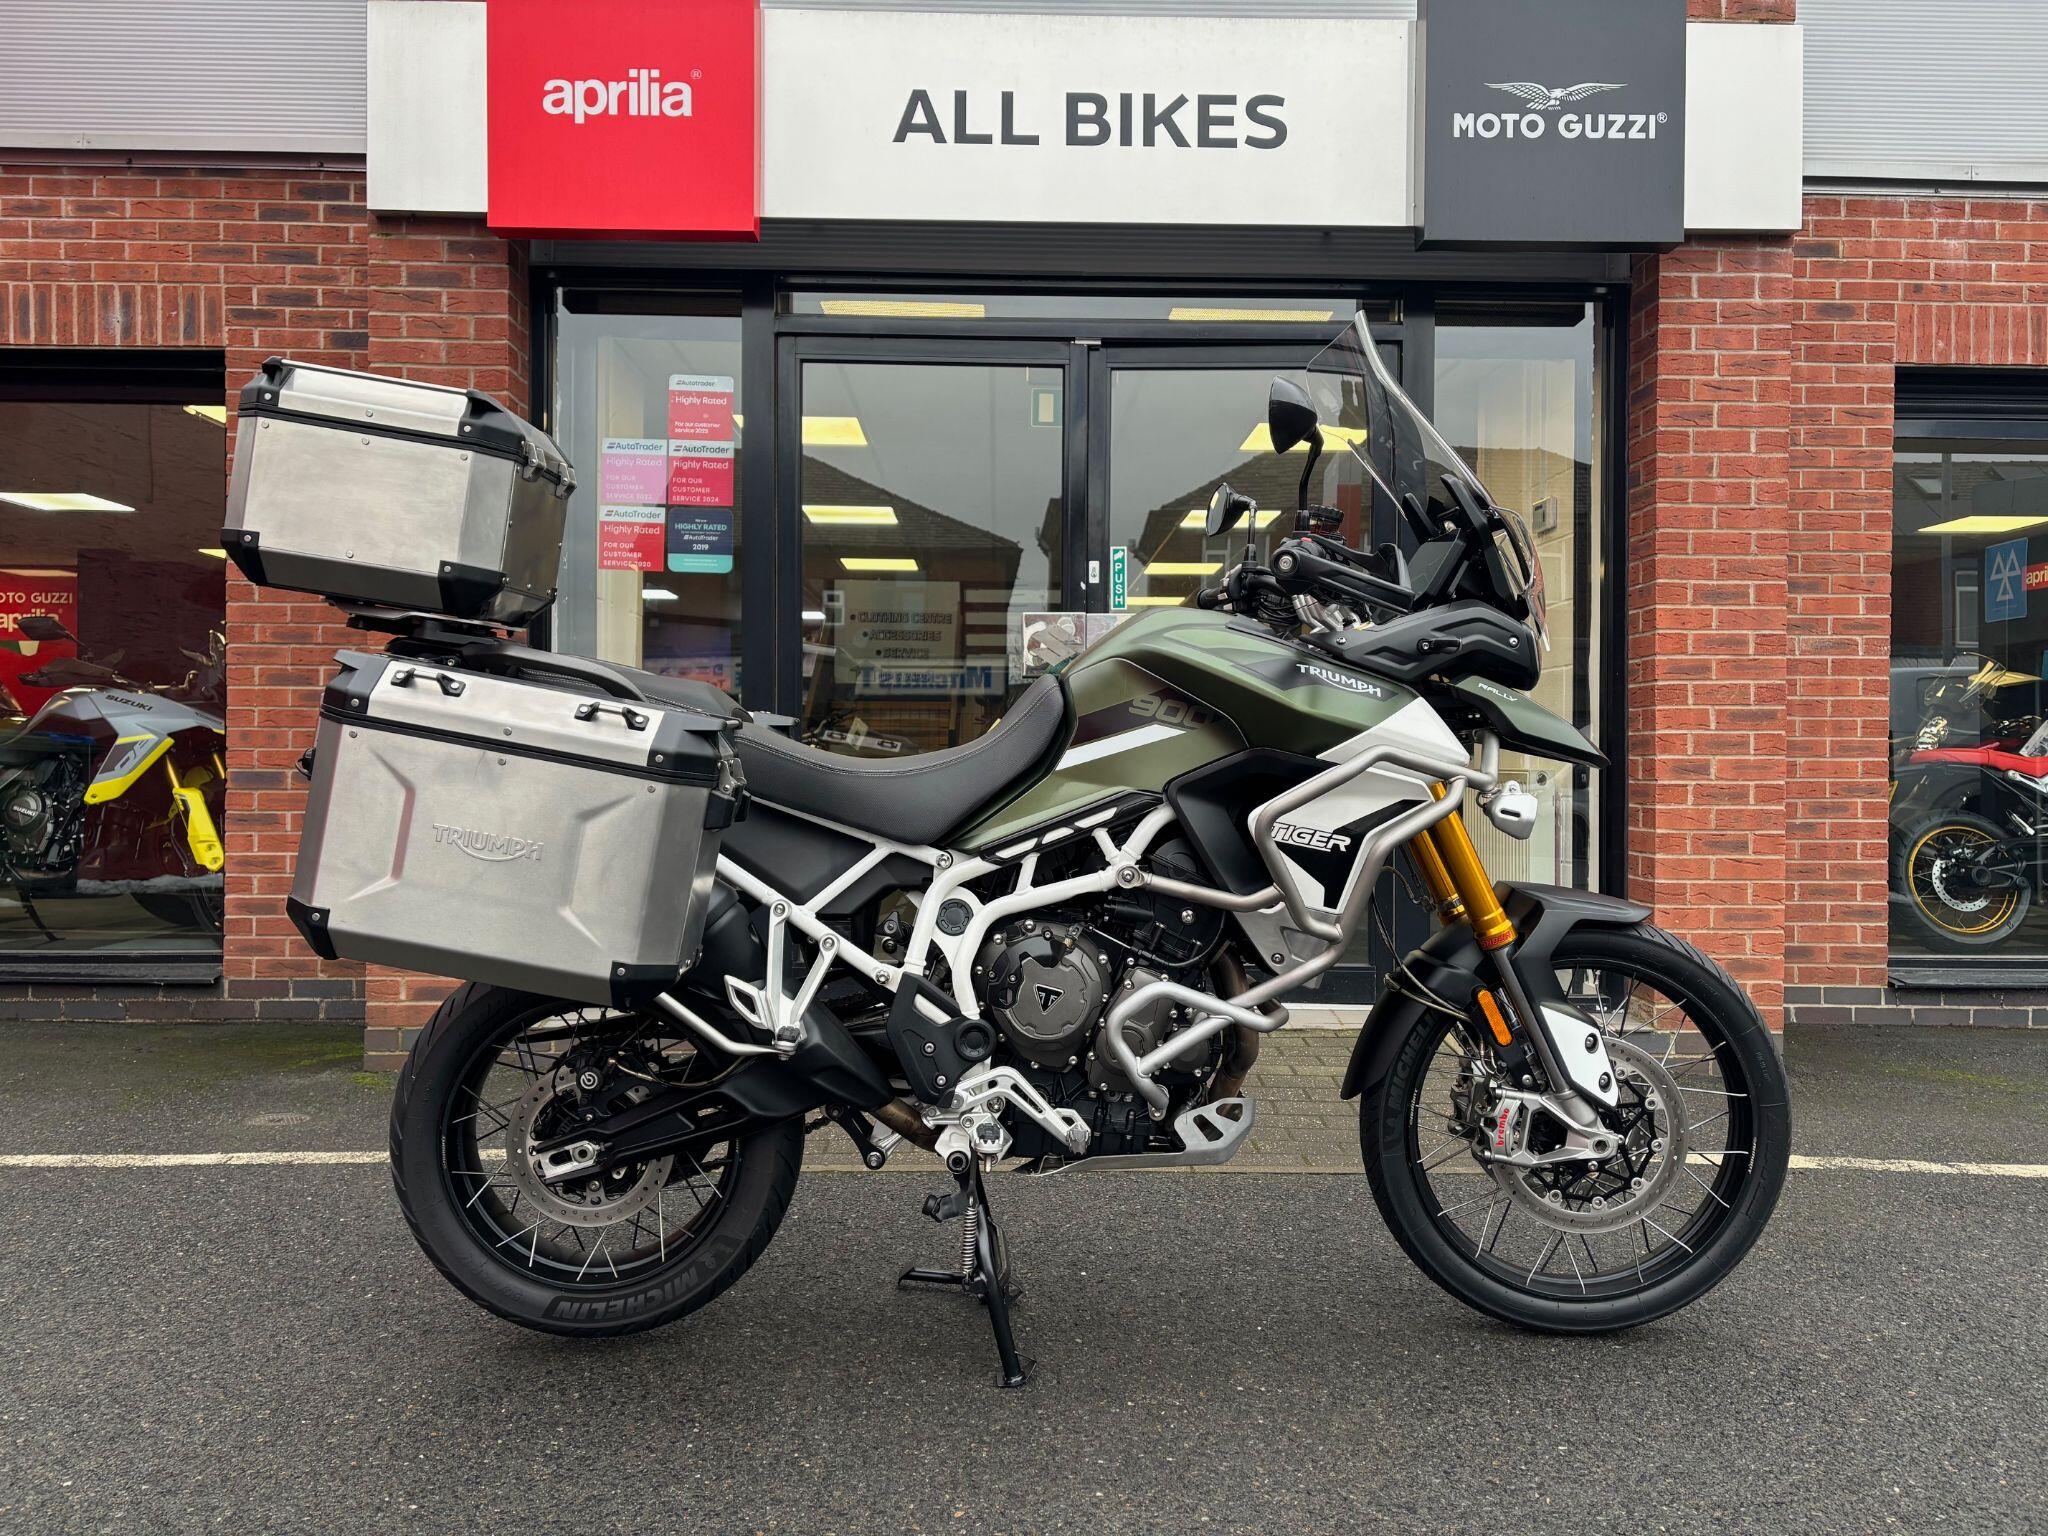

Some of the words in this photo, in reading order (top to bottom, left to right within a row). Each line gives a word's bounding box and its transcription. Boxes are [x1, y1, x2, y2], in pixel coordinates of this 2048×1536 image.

[892, 89, 1040, 145] ALL
[1065, 91, 1289, 150] BIKES
[1453, 112, 1546, 139] MOTO
[675, 395, 702, 406] Highly
[702, 396, 727, 405] Rated
[615, 442, 663, 451] AutoTrader
[682, 445, 729, 454] AutoTrader
[606, 457, 634, 467] Highly
[635, 458, 662, 466] Rated
[673, 460, 702, 470] Highly
[702, 461, 728, 470] Rated
[613, 509, 661, 519] AutoTrader
[604, 524, 631, 535] Highly
[633, 525, 660, 535] Rated
[675, 522, 702, 531] HIGHLY
[703, 523, 727, 531] RATED
[692, 543, 709, 551] 2019
[603, 550, 642, 558] CUSTOMER
[1114, 562, 1124, 606] PUSH
[30, 591, 73, 604] GUZZI
[857, 611, 909, 624] CLOTHING
[911, 612, 953, 625] CENTRE
[869, 628, 942, 642] ACCESSORIES
[882, 647, 930, 659] SERVICE
[1295, 663, 1381, 698] TRIUMPH
[1478, 682, 1518, 702] RALLY
[105, 694, 154, 712] SUZUKI
[1128, 694, 1213, 730] 900
[12, 804, 38, 817] SUZUKI
[432, 823, 545, 862] TRIUMPH
[1270, 821, 1352, 853] TIGER
[1495, 1107, 1510, 1147] brembo
[551, 1265, 700, 1320] MICHELIN
